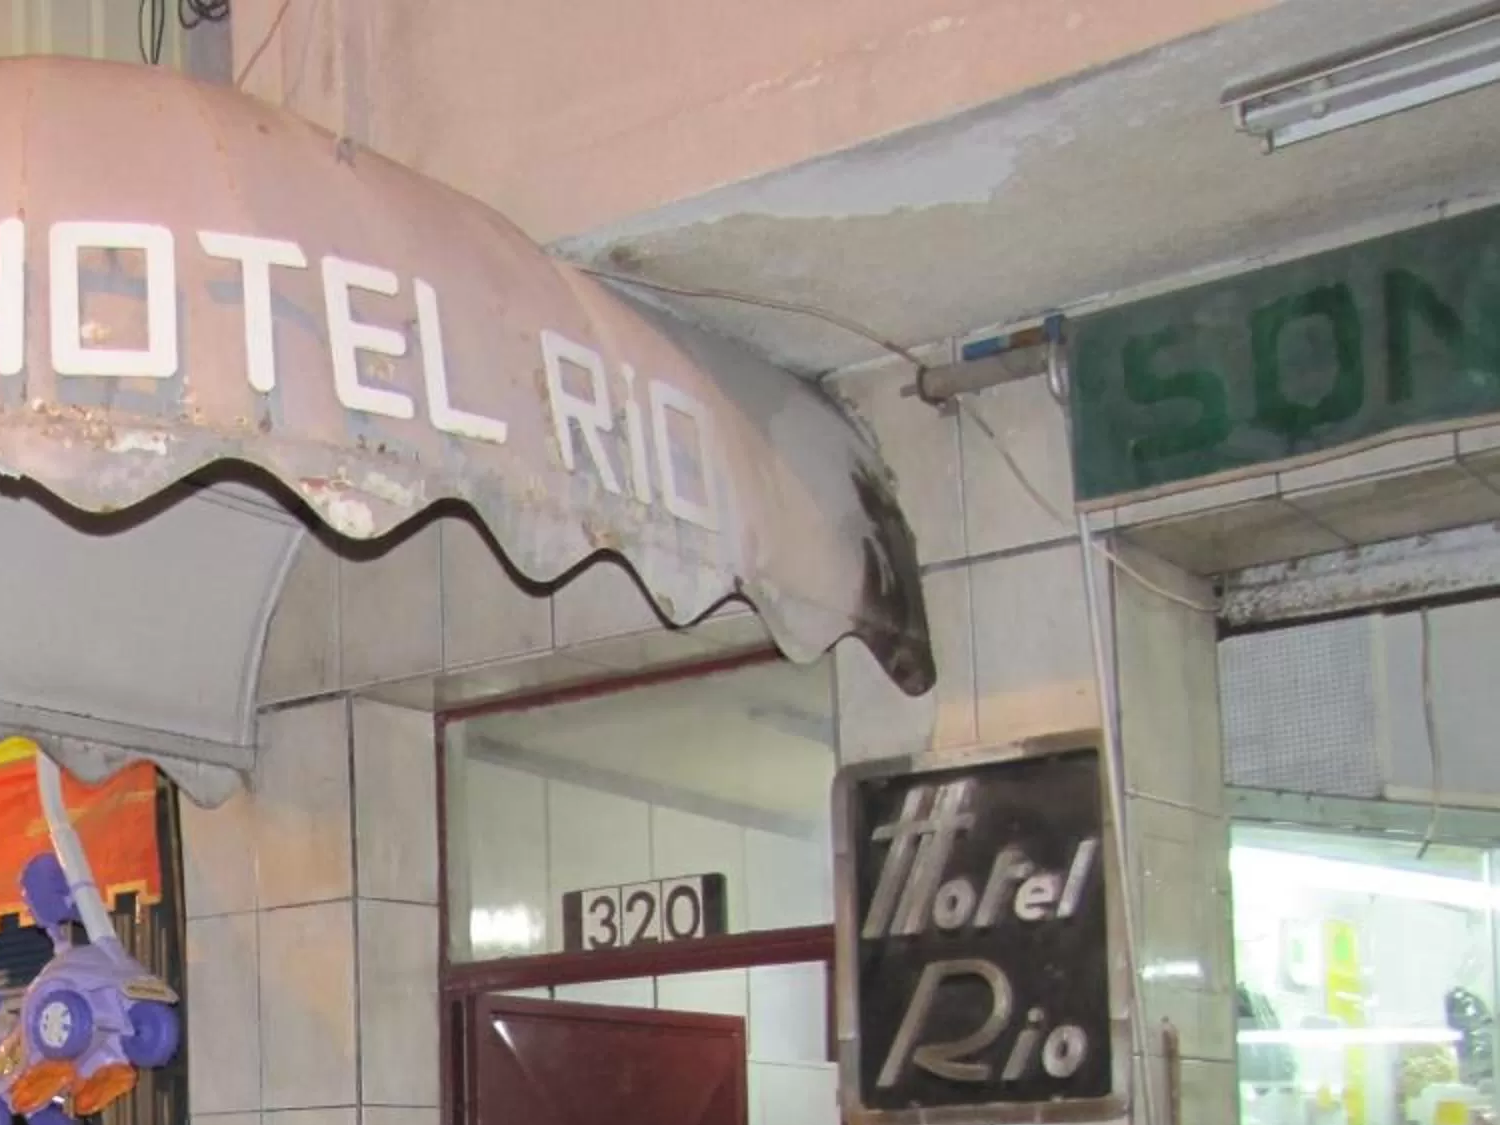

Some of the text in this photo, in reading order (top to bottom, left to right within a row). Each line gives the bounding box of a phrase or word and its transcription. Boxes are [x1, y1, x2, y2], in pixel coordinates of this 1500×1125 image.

[588, 885, 700, 950] 320
[862, 778, 1097, 940] Hotel
[876, 959, 1088, 1088] Rio
